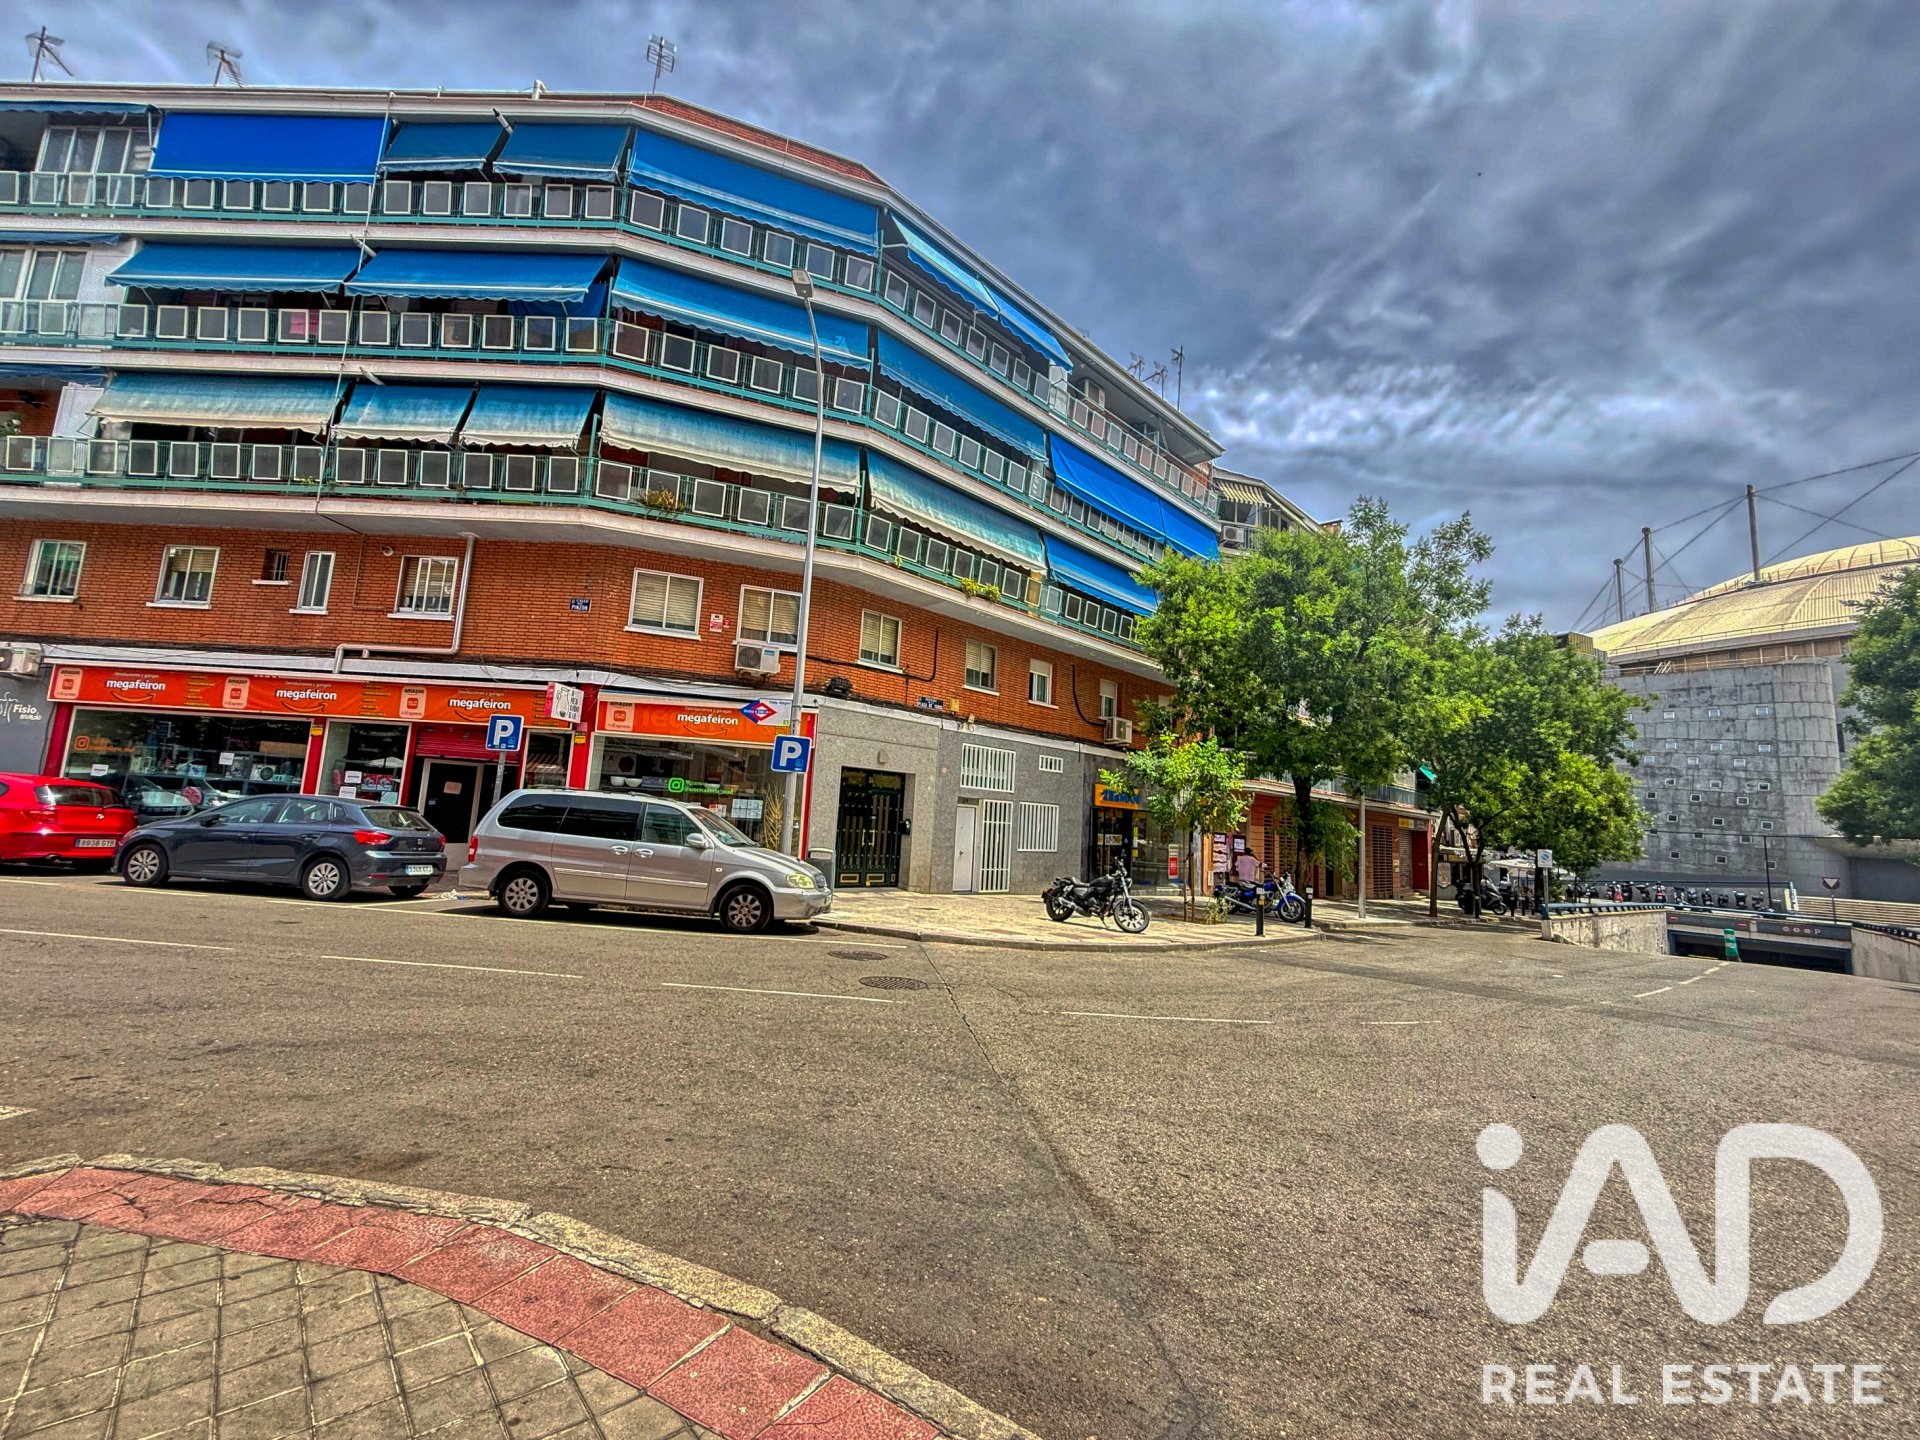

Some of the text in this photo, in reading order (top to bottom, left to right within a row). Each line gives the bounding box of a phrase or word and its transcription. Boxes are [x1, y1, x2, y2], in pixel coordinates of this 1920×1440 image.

[106, 679, 165, 691] megafeiron
[276, 688, 337, 700] megafeiron
[13, 704, 37, 714] Fisio
[449, 698, 511, 710] megafeiron
[677, 713, 738, 725] megafeiron
[493, 720, 514, 745] P
[779, 740, 802, 767] P
